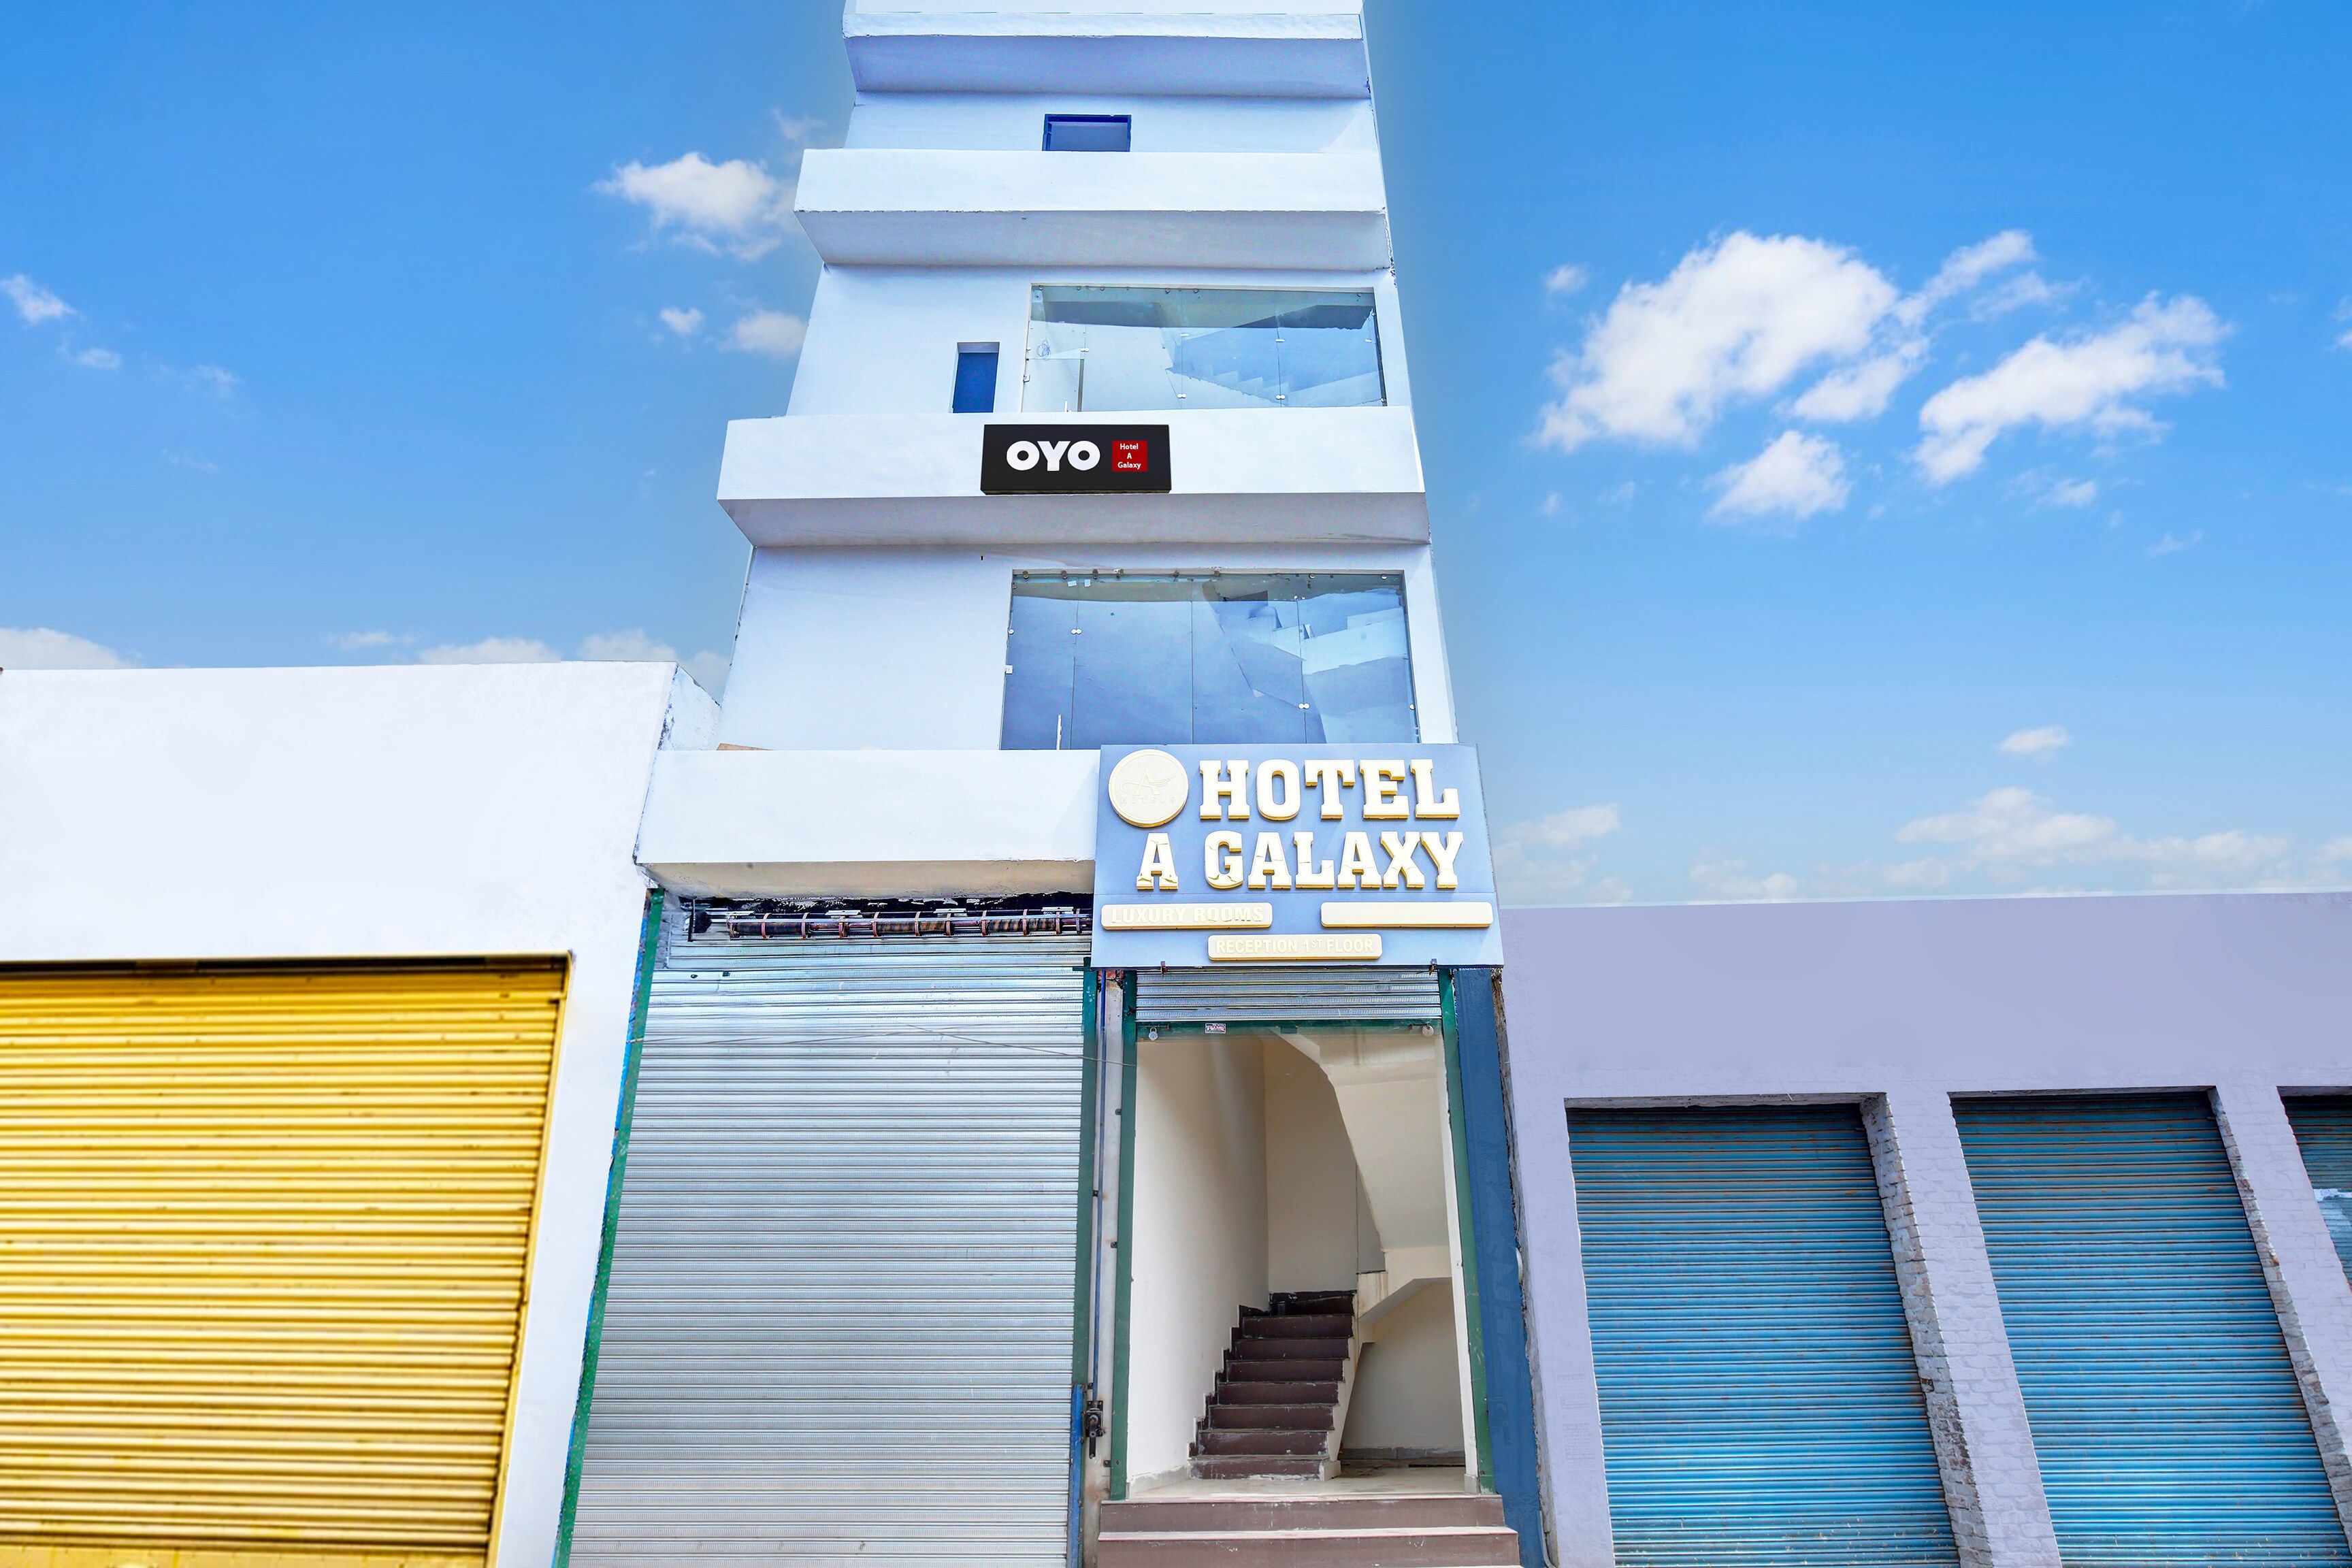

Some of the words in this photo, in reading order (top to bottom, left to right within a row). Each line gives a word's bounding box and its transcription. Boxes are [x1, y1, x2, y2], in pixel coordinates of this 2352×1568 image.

[1006, 440, 1100, 472] OYO
[1117, 461, 1141, 470] Galaxy
[1199, 759, 1460, 820] HOTEL
[1136, 832, 1179, 890] A
[1205, 830, 1464, 889] GALAXY
[1111, 906, 1186, 924] LUXURY
[1193, 906, 1264, 922] ROOMS
[1215, 938, 1298, 953] RECEPTION
[1326, 937, 1374, 953] FLOOR
